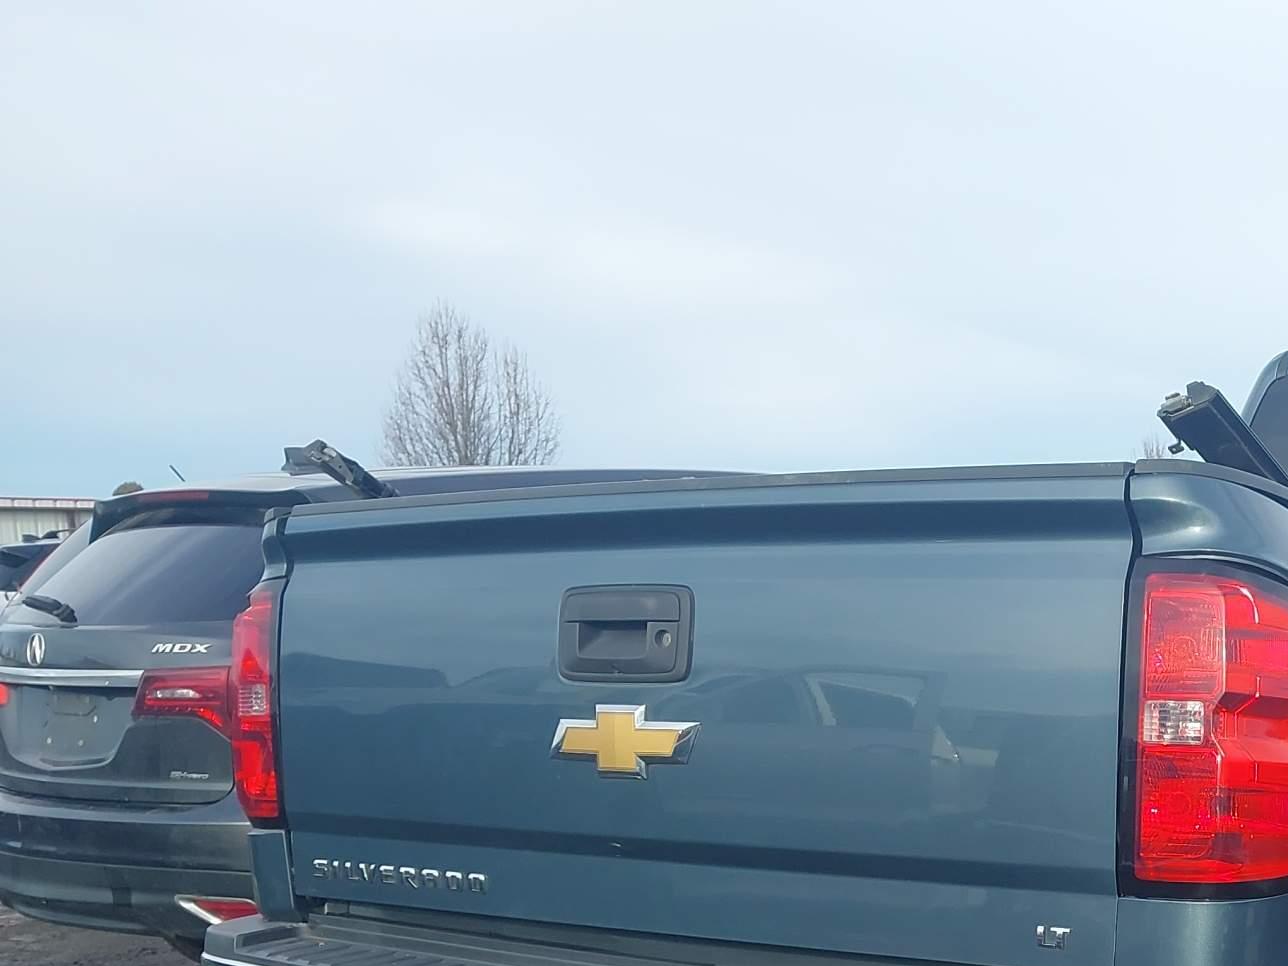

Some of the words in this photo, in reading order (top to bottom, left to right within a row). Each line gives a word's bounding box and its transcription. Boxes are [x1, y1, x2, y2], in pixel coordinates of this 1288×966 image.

[151, 643, 212, 653] MDX
[312, 859, 487, 894] SILVERADO
[1036, 925, 1071, 950] LT
